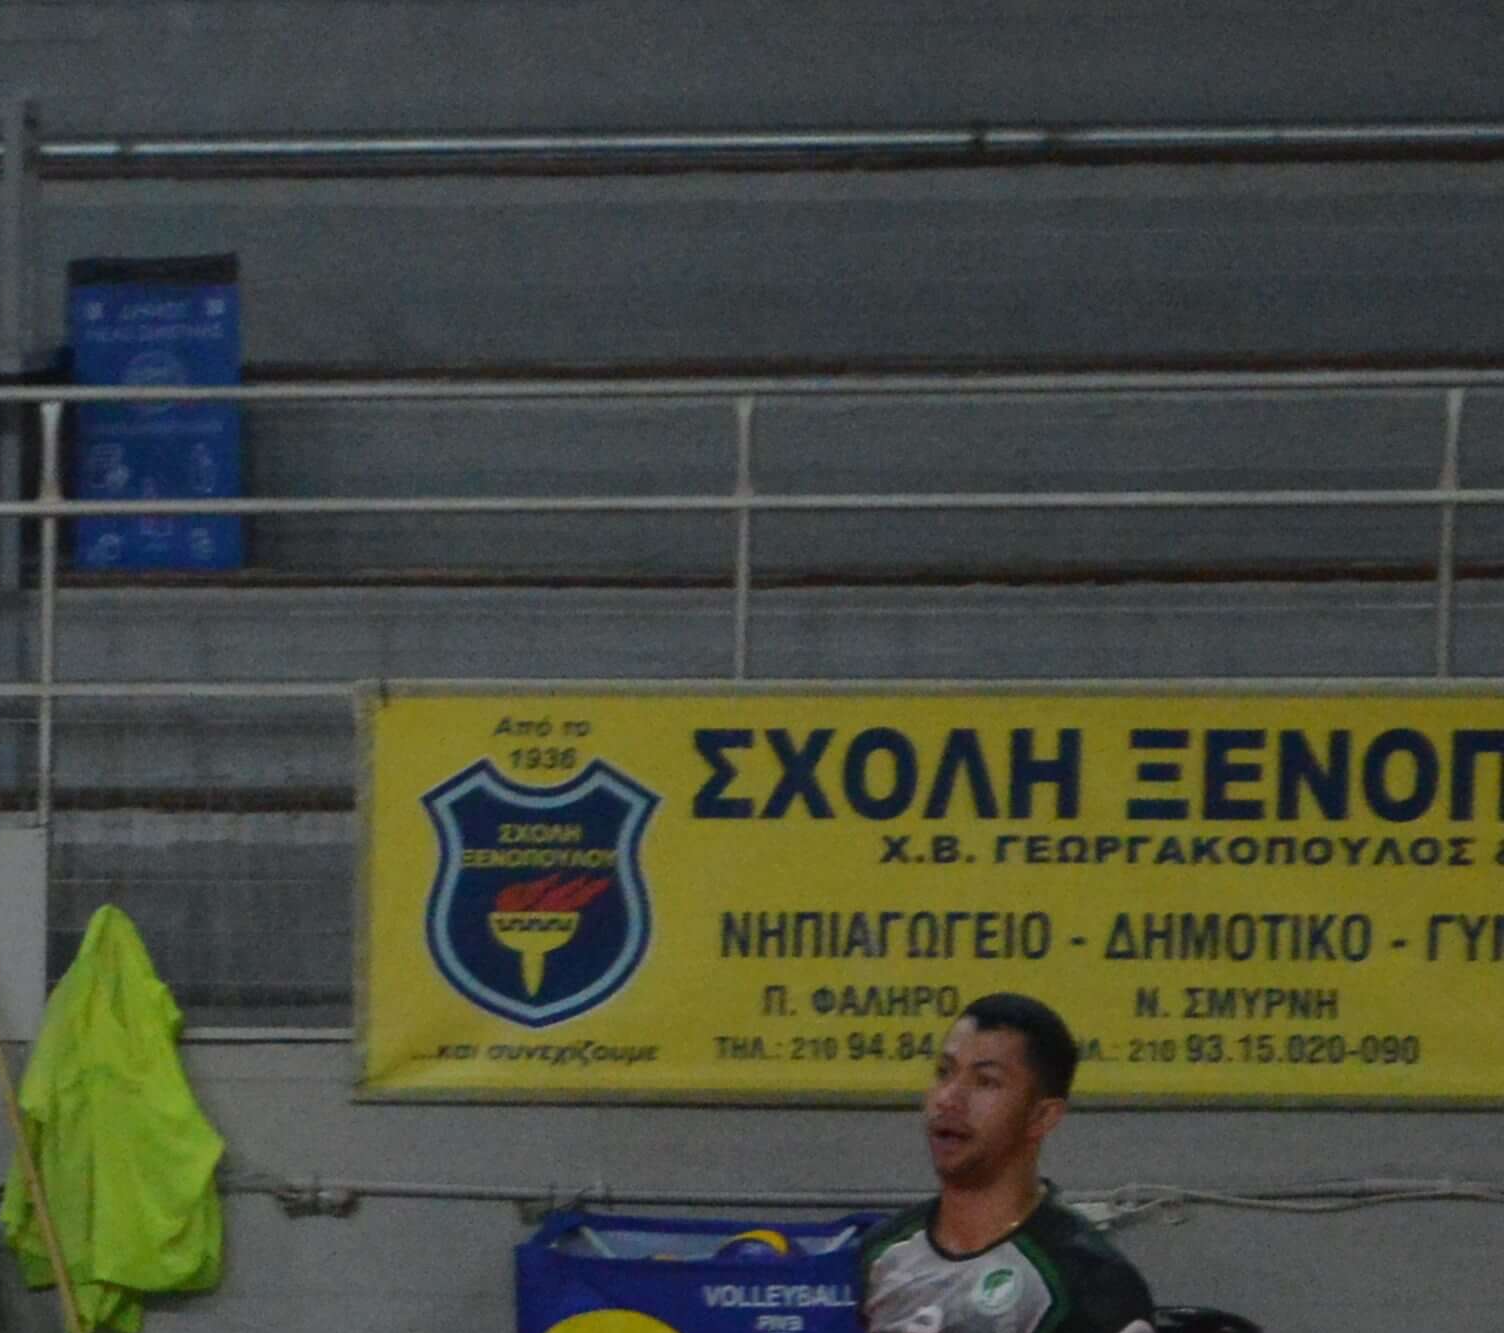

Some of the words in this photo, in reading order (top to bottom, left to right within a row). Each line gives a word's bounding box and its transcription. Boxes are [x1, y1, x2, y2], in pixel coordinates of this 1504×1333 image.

[692, 727, 1082, 820] ΣΧΟΛΗ
[1126, 727, 1504, 822] ΞΕΝΟΠ
[993, 834, 1475, 866] ΓΕΩΡΓΑΚΟΠΟΥΛΟΣ
[720, 911, 1053, 959] ΝΗΠΙΑΓΩΓΕΙΟ
[1104, 911, 1373, 962] ΔΗΜΟΤΙΚΟ
[810, 985, 960, 1017] ΦΑΛΗΡΟ
[1184, 987, 1340, 1019] ΣΜΥΡΝΗ
[702, 1283, 858, 1307] VOLLEYBALL
